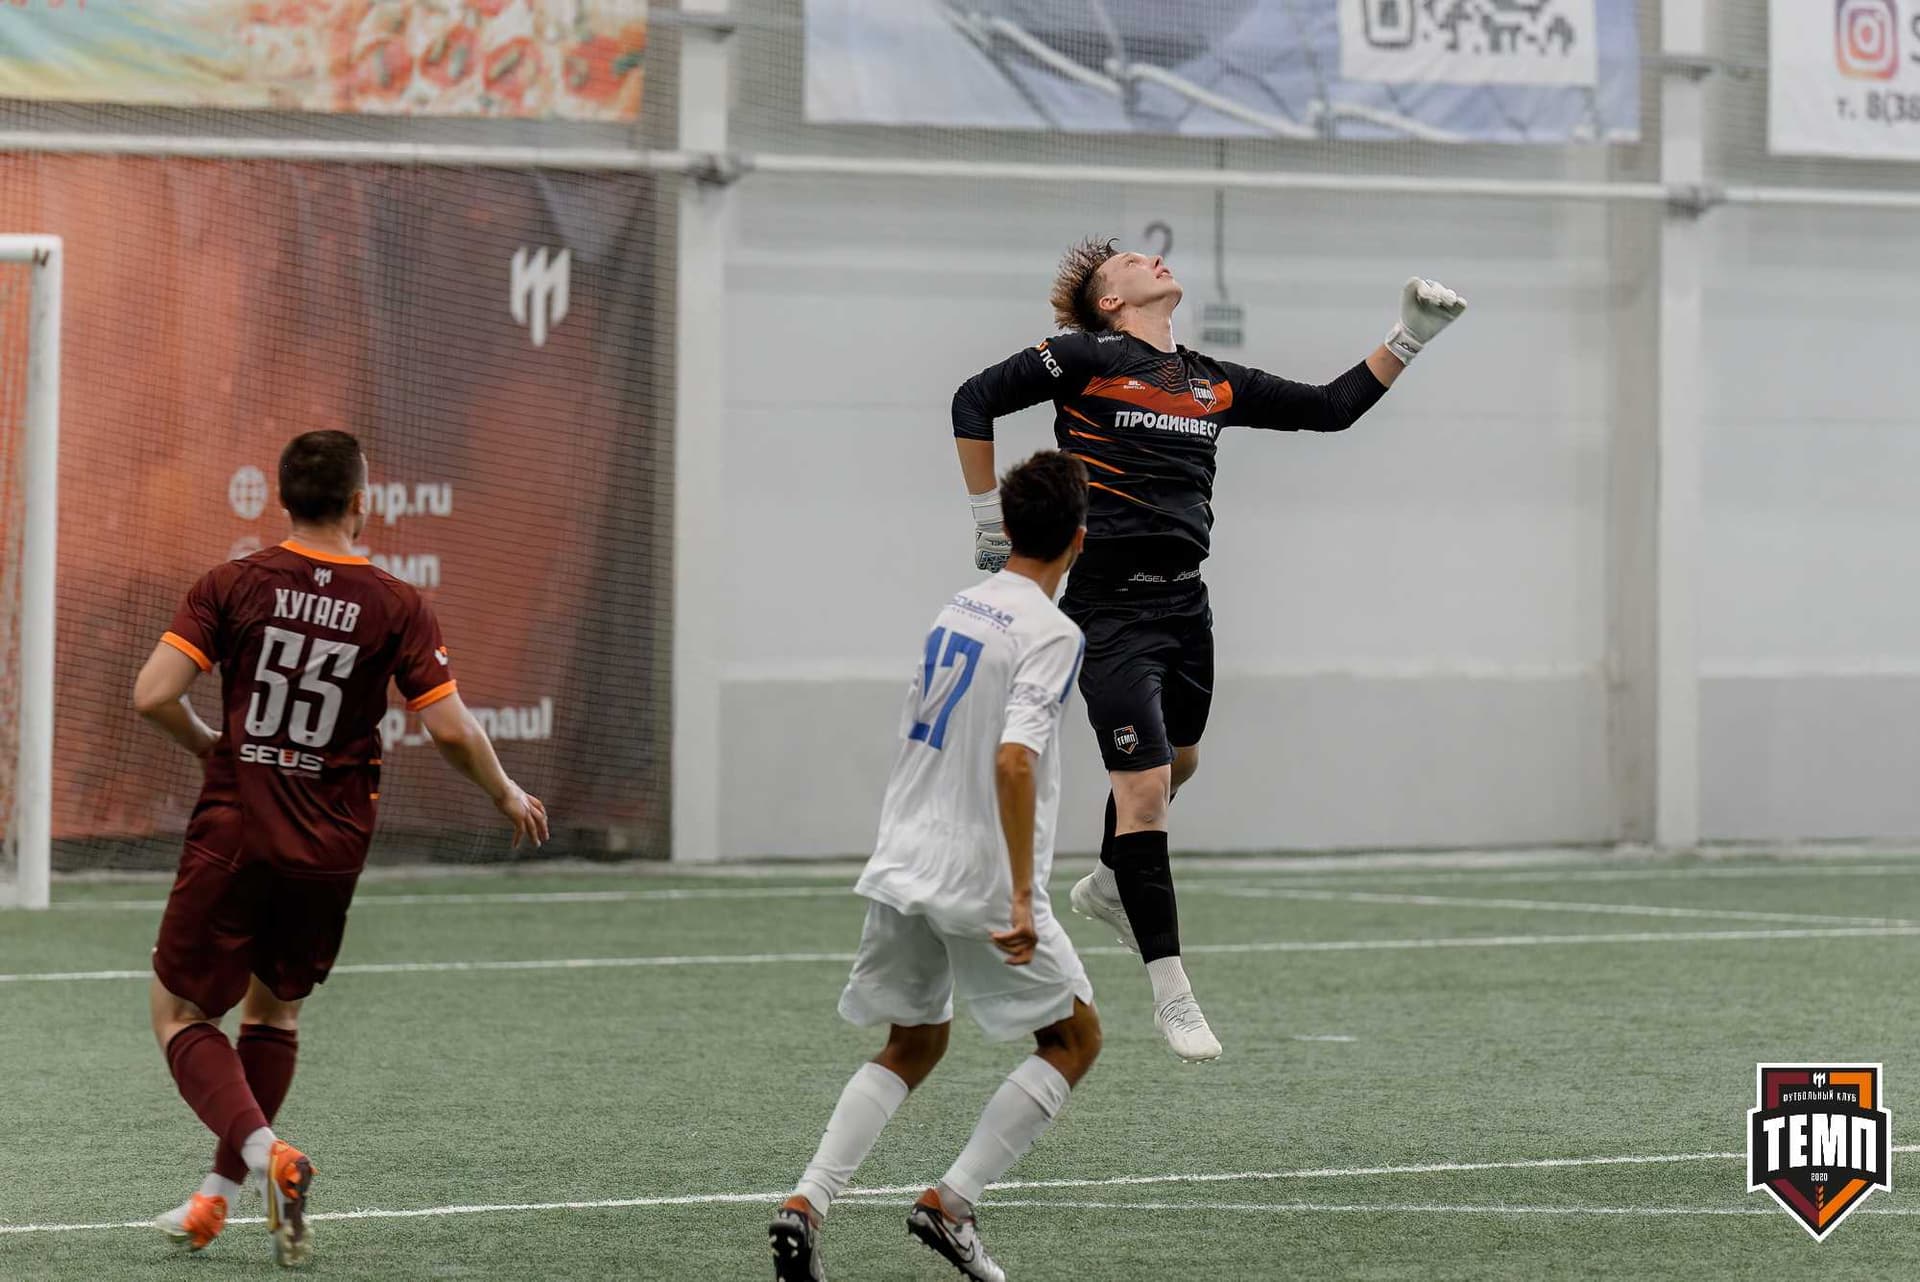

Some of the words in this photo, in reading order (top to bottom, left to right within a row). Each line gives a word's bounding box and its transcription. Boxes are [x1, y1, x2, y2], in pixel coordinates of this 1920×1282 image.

[1040, 349, 1063, 378] ПСБ
[1128, 572, 1167, 583] JÖGEL
[274, 588, 361, 632] ХУГАЕВ
[244, 626, 360, 748] 55
[908, 626, 985, 751] 17
[1117, 733, 1136, 747] ТЕМП
[240, 743, 325, 771] SEUS
